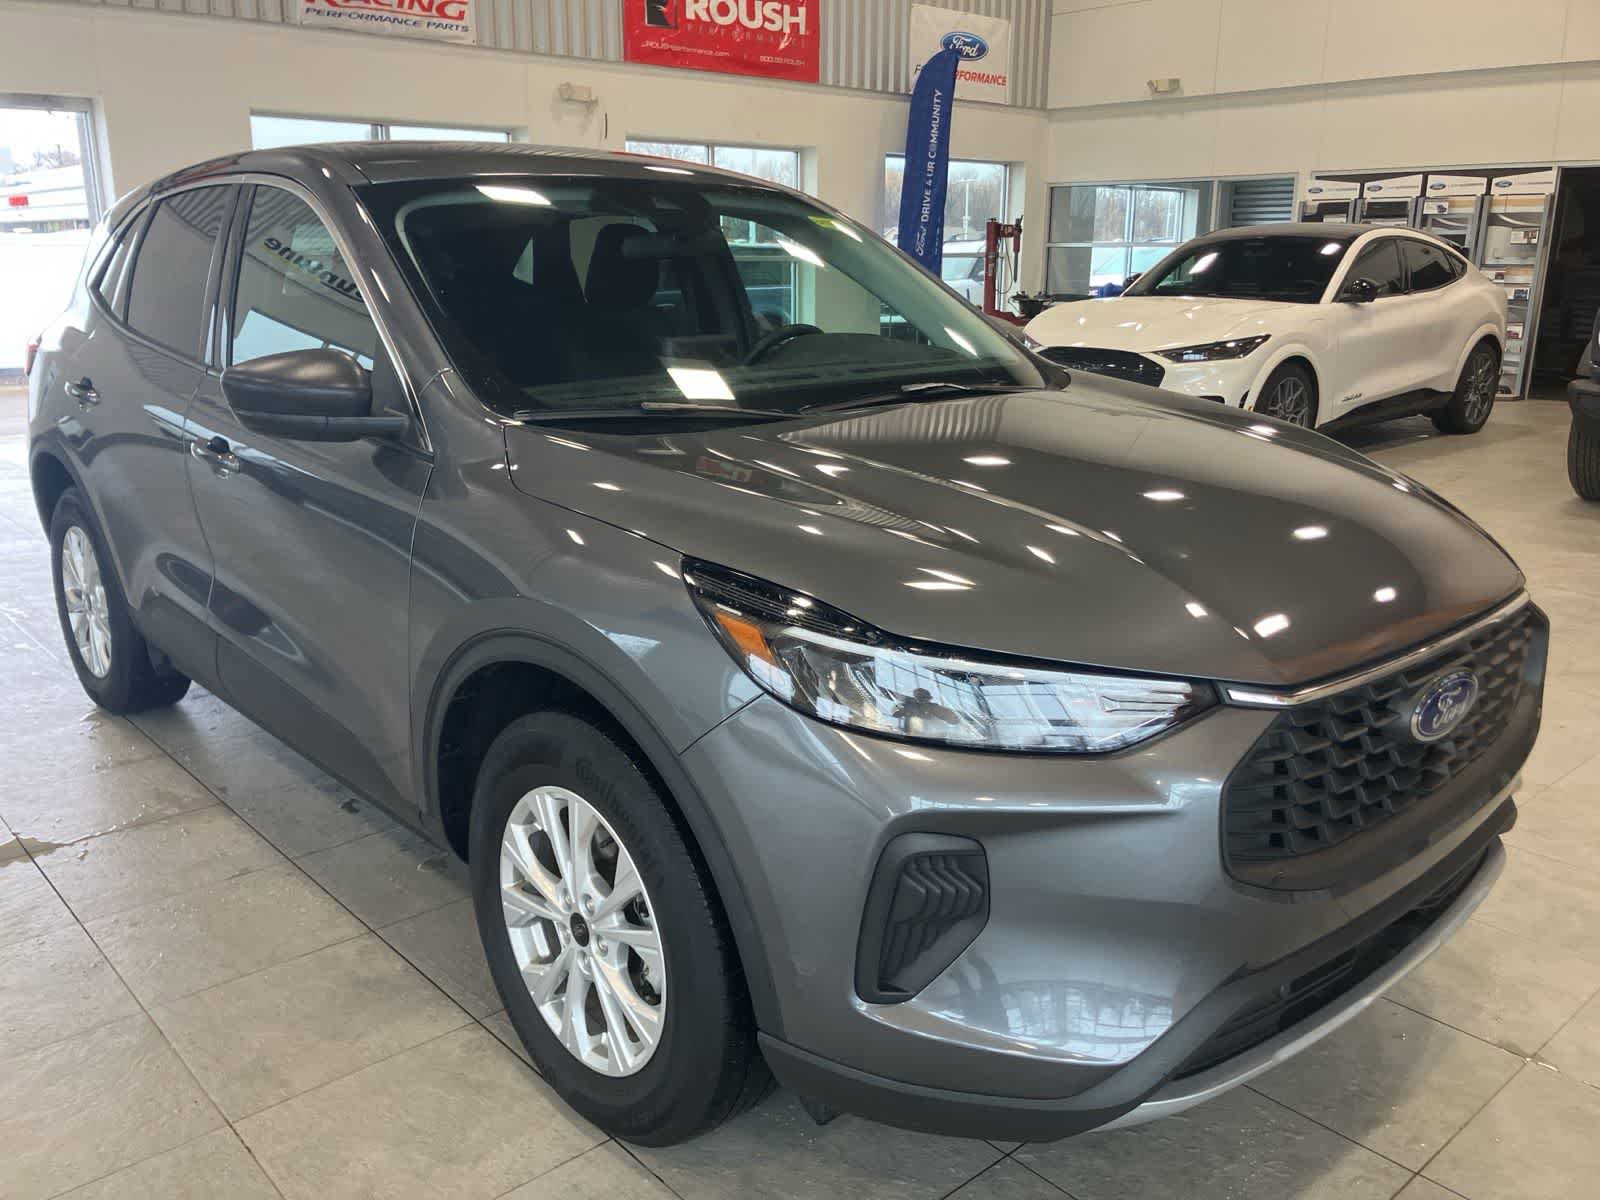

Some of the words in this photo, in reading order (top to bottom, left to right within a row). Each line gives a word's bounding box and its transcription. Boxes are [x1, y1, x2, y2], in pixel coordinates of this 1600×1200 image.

[303, 0, 469, 21] ING
[305, 7, 423, 28] PERFORMANCE
[426, 21, 470, 32] PARTS
[685, 0, 806, 35] ROUSH
[956, 69, 1007, 87] FORMANCE
[928, 88, 943, 159] COMMUNITY
[926, 161, 936, 177] UR
[920, 190, 932, 222] DRIVE
